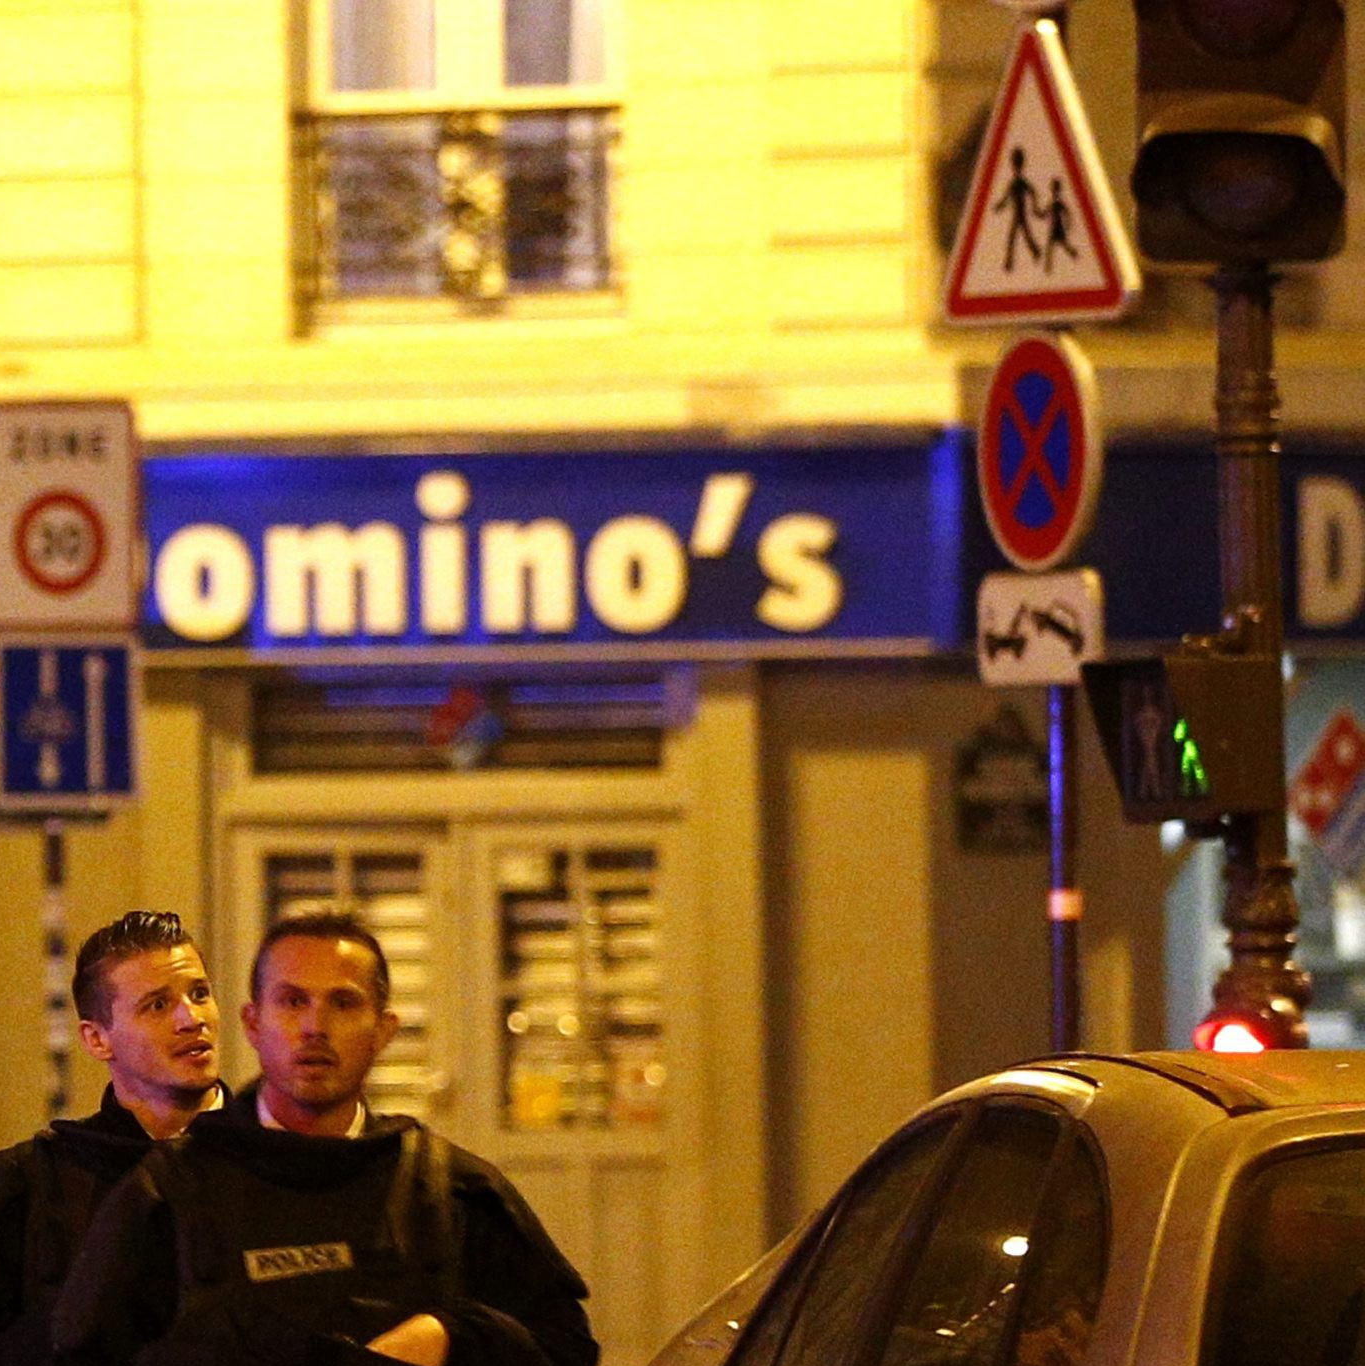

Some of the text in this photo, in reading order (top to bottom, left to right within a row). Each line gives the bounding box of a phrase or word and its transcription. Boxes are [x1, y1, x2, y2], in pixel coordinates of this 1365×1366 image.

[8, 425, 110, 463] ZONE
[154, 469, 843, 641] omino's
[258, 1246, 342, 1273] POLICE
